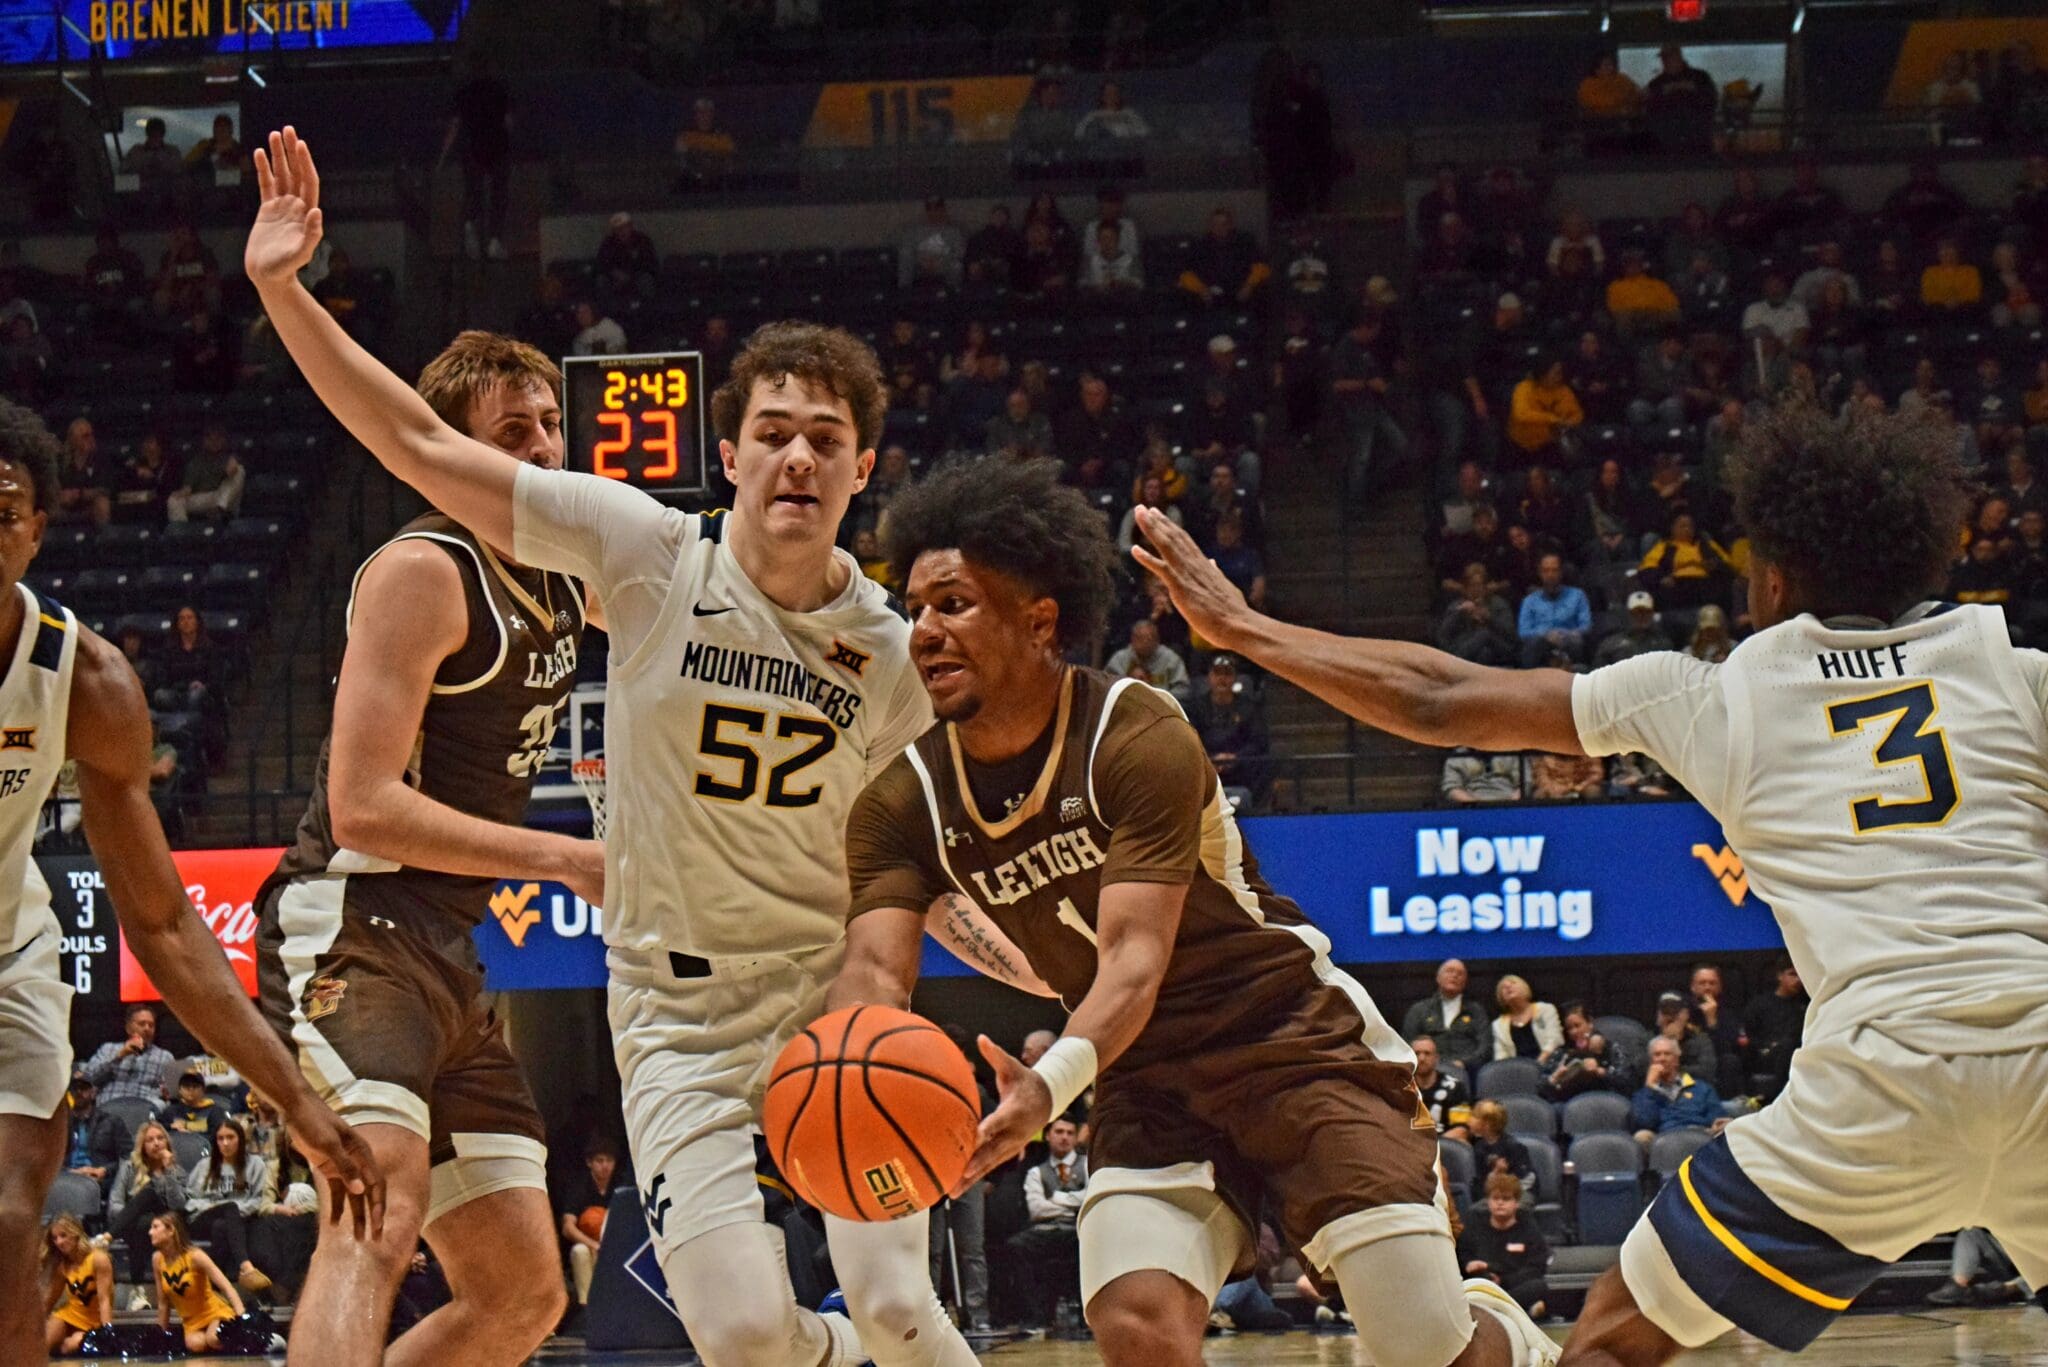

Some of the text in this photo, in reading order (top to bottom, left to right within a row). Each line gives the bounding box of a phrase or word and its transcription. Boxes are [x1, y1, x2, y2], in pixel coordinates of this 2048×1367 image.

[90, 0, 209, 42] BRENEN
[866, 86, 955, 145] 115
[604, 368, 687, 409] 2:43
[594, 410, 677, 479] 23
[680, 640, 862, 729] MOUNTAINEERS
[1817, 641, 1907, 679] HUFF
[694, 700, 842, 808] 52
[1824, 679, 1963, 836] 3
[970, 826, 1107, 905] LEHIGH
[1417, 828, 1545, 877] Now
[67, 872, 106, 889] TOL
[76, 889, 95, 929] 3
[1370, 877, 1593, 940] Leasing
[58, 936, 107, 954] OULS
[75, 954, 92, 994] 6
[864, 1163, 919, 1220] ELIT
